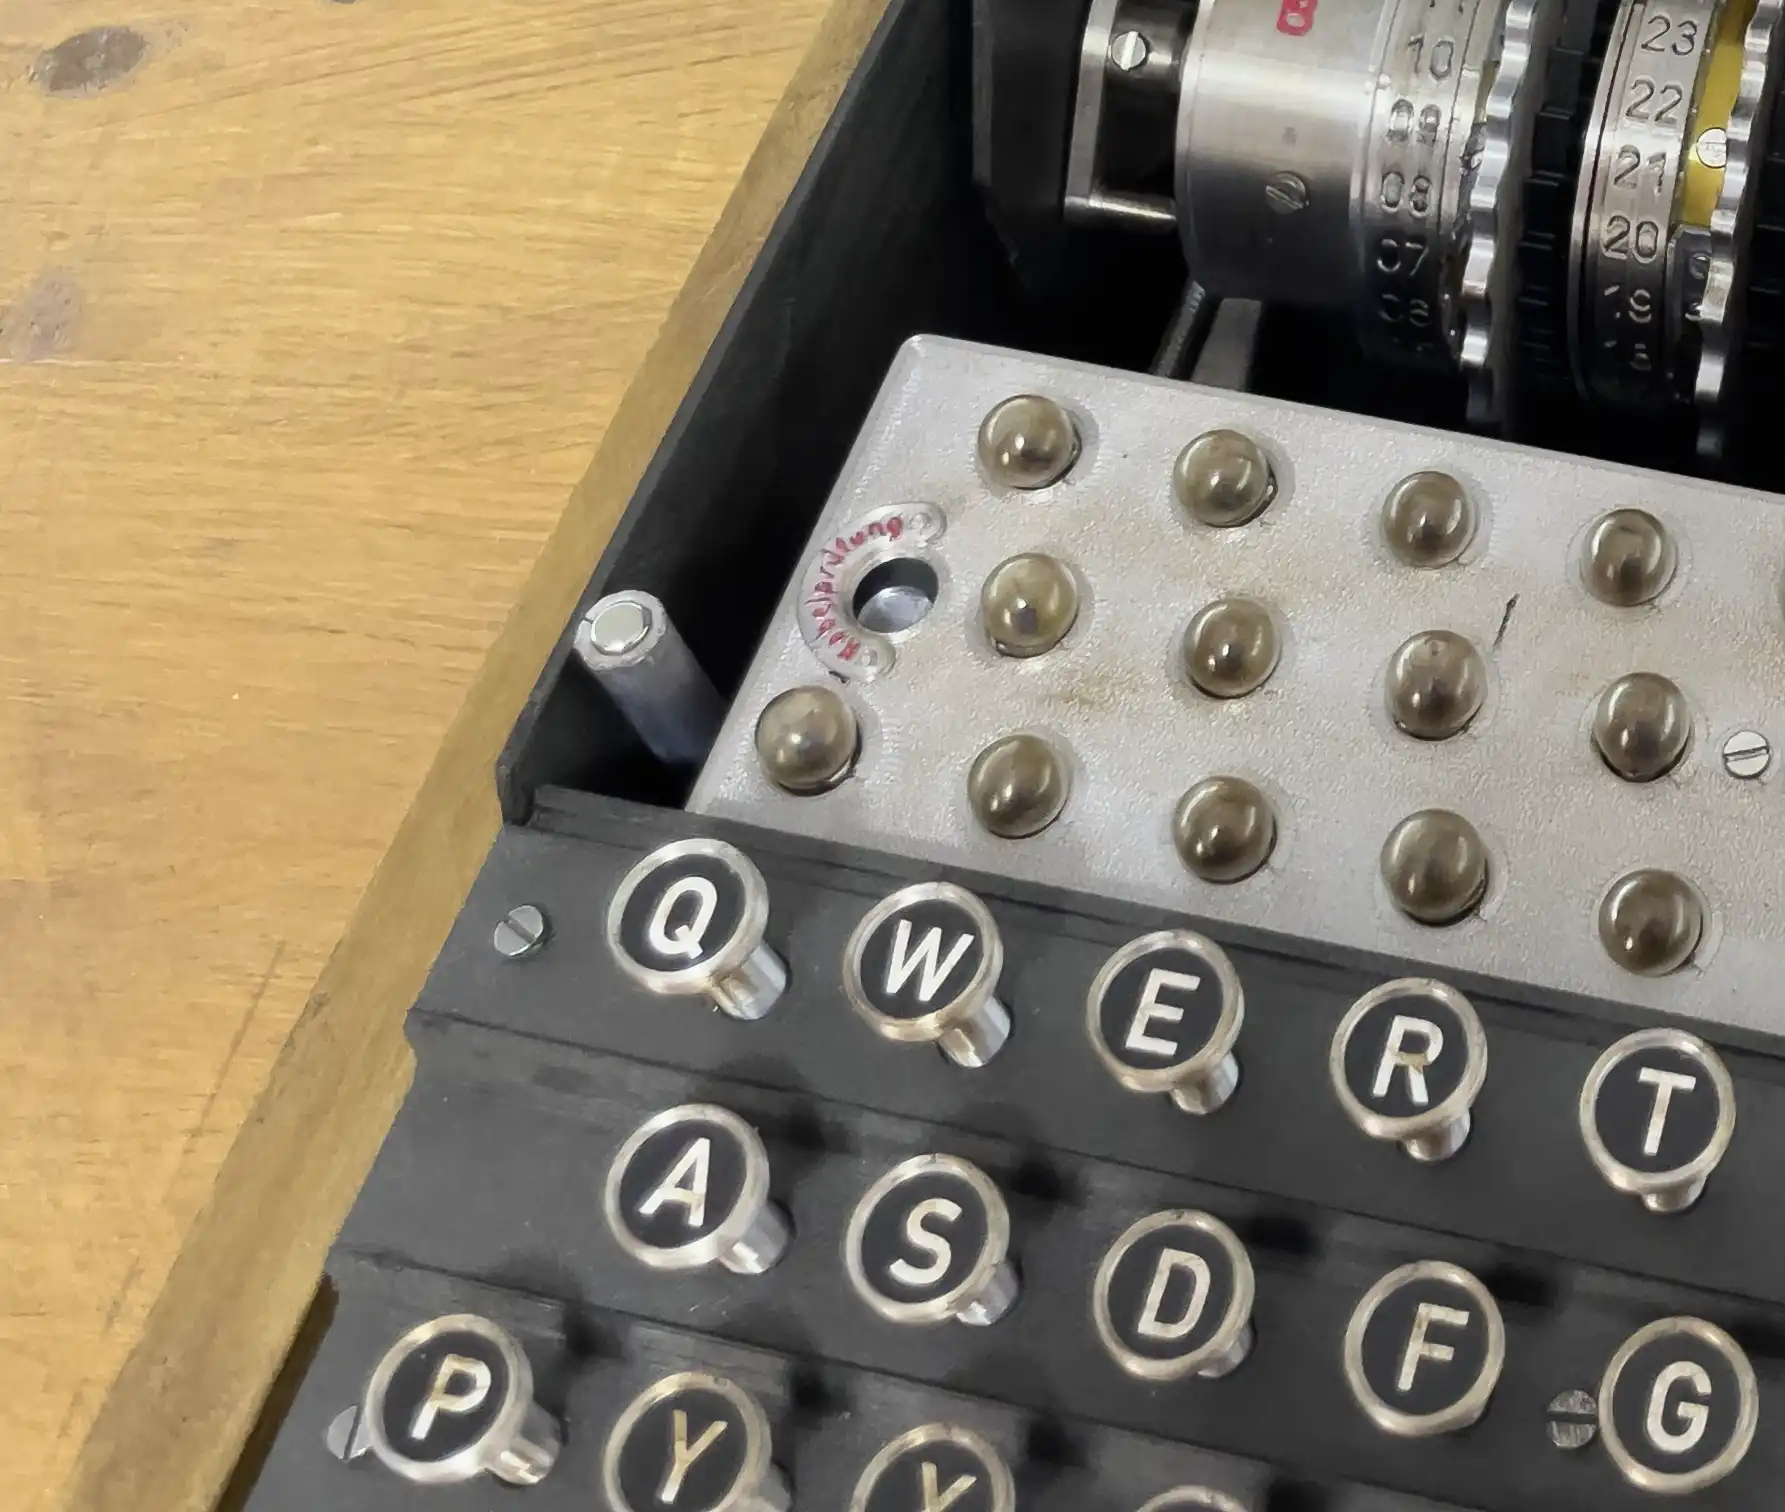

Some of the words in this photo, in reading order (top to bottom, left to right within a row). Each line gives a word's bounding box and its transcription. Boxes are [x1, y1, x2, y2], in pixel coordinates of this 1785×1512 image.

[1406, 34, 1455, 81] 10
[1640, 14, 1698, 56] 23
[1625, 76, 1683, 125] 22
[1613, 143, 1668, 192] 21
[1603, 214, 1660, 264] 20
[649, 875, 718, 960] Q
[884, 918, 975, 1003] W
[1125, 967, 1201, 1056] E
[1372, 1015, 1444, 1104] R
[1636, 1066, 1697, 1157] T
[638, 1136, 712, 1227] A
[888, 1197, 964, 1285] S
[1136, 1247, 1212, 1339] D
[1398, 1301, 1470, 1392] F
[410, 1354, 491, 1441] P
[1644, 1359, 1713, 1455] G
[658, 1409, 729, 1503] Y
